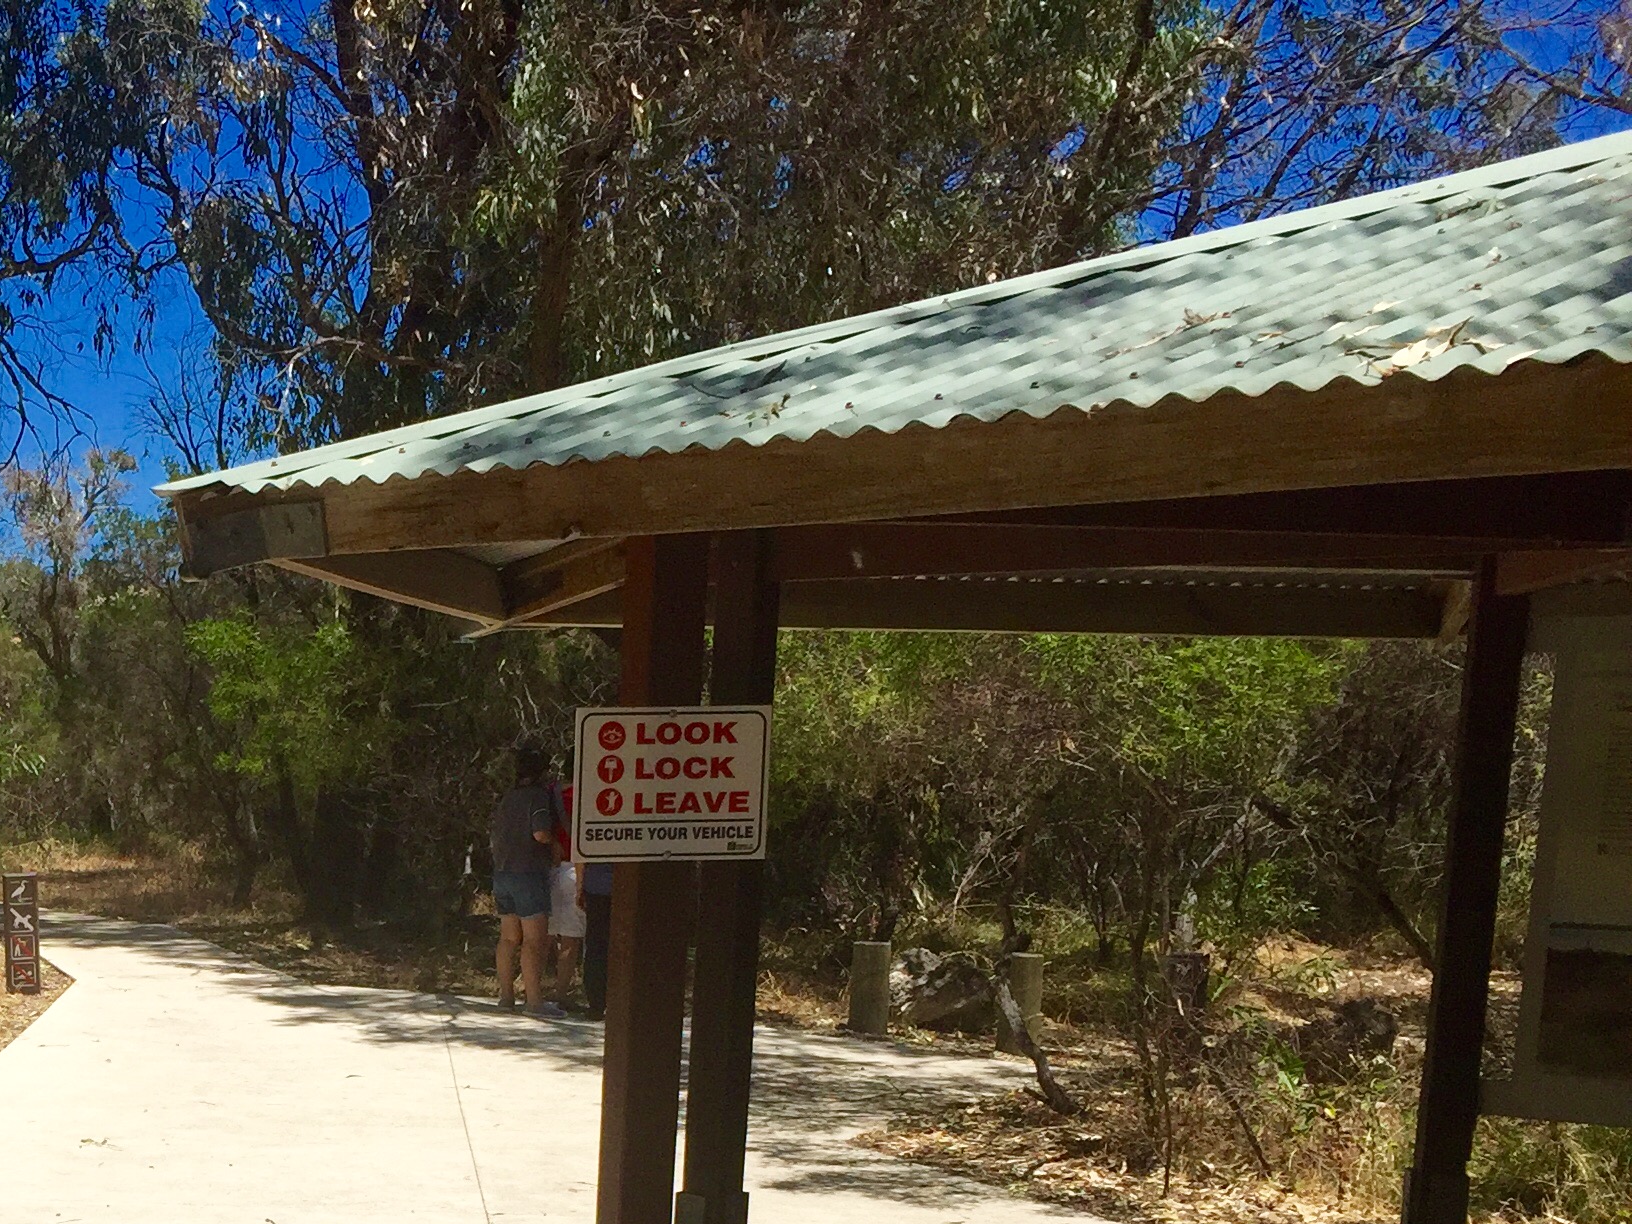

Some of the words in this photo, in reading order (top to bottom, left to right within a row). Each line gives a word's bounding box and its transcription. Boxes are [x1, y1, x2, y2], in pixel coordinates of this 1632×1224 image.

[636, 721, 738, 745] LOOK
[635, 756, 735, 780] LOCK
[633, 791, 750, 814] LEAVE
[585, 827, 643, 842] SECURE
[648, 826, 688, 840] YOUR
[692, 825, 754, 839] VEHICLE
